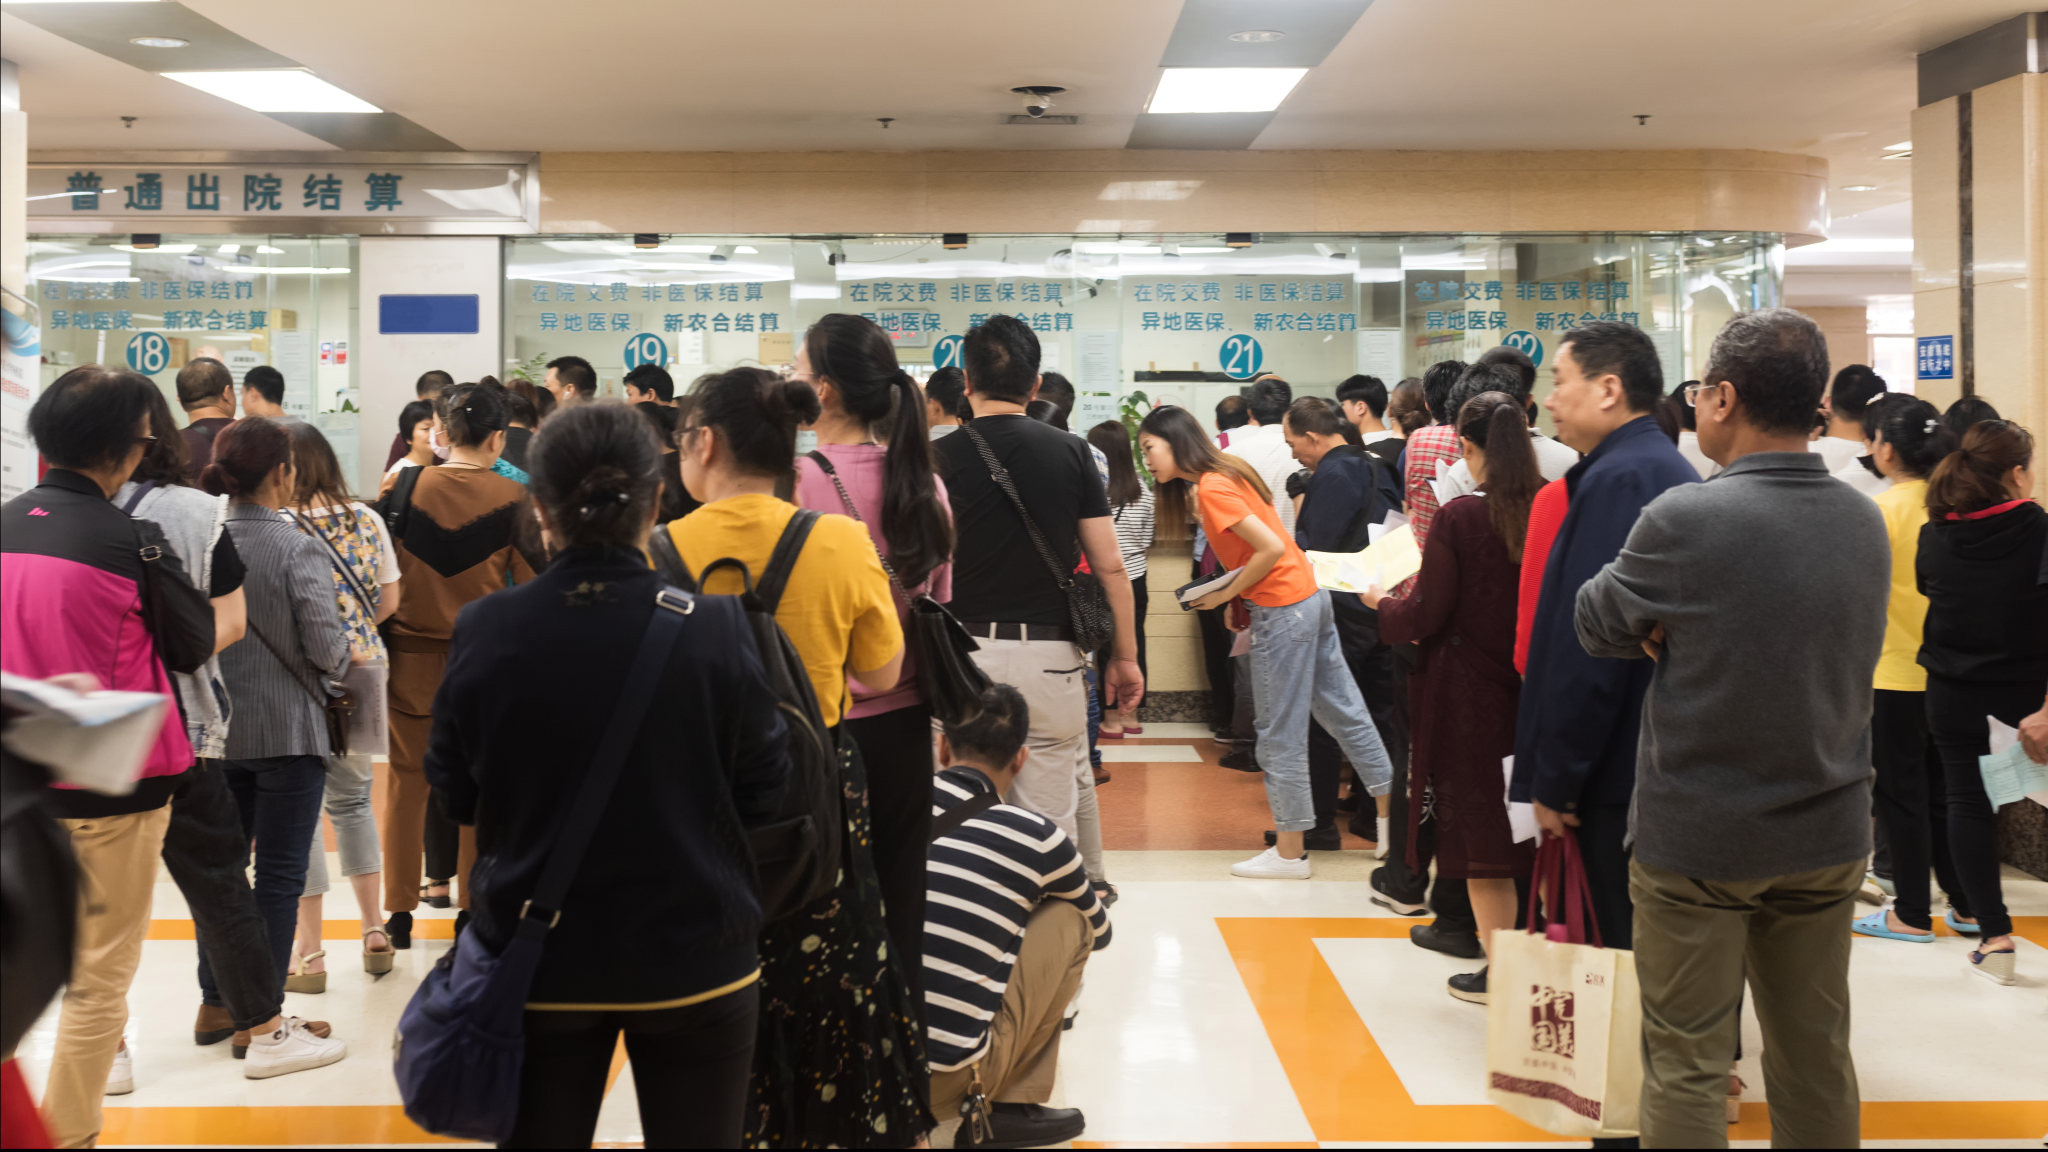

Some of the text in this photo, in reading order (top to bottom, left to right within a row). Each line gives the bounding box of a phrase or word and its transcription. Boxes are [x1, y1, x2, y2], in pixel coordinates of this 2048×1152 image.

[67, 172, 403, 211] 普通出院结算
[140, 281, 253, 300] 非医保结算
[531, 282, 764, 302] 在院交费 非医保结算
[849, 282, 1063, 302] 在院交费 非医保结算
[1133, 282, 1345, 302] 在院交费 非医保结算
[1415, 281, 1630, 301] 在院交费 非医保结算
[163, 309, 268, 331] 新农合结算
[664, 313, 780, 332] 新农合结算
[969, 312, 1073, 331] 新结算
[1253, 312, 1357, 332] 新农合结算
[130, 335, 164, 372] 18
[627, 337, 661, 369] 19
[1226, 338, 1254, 374] 21
